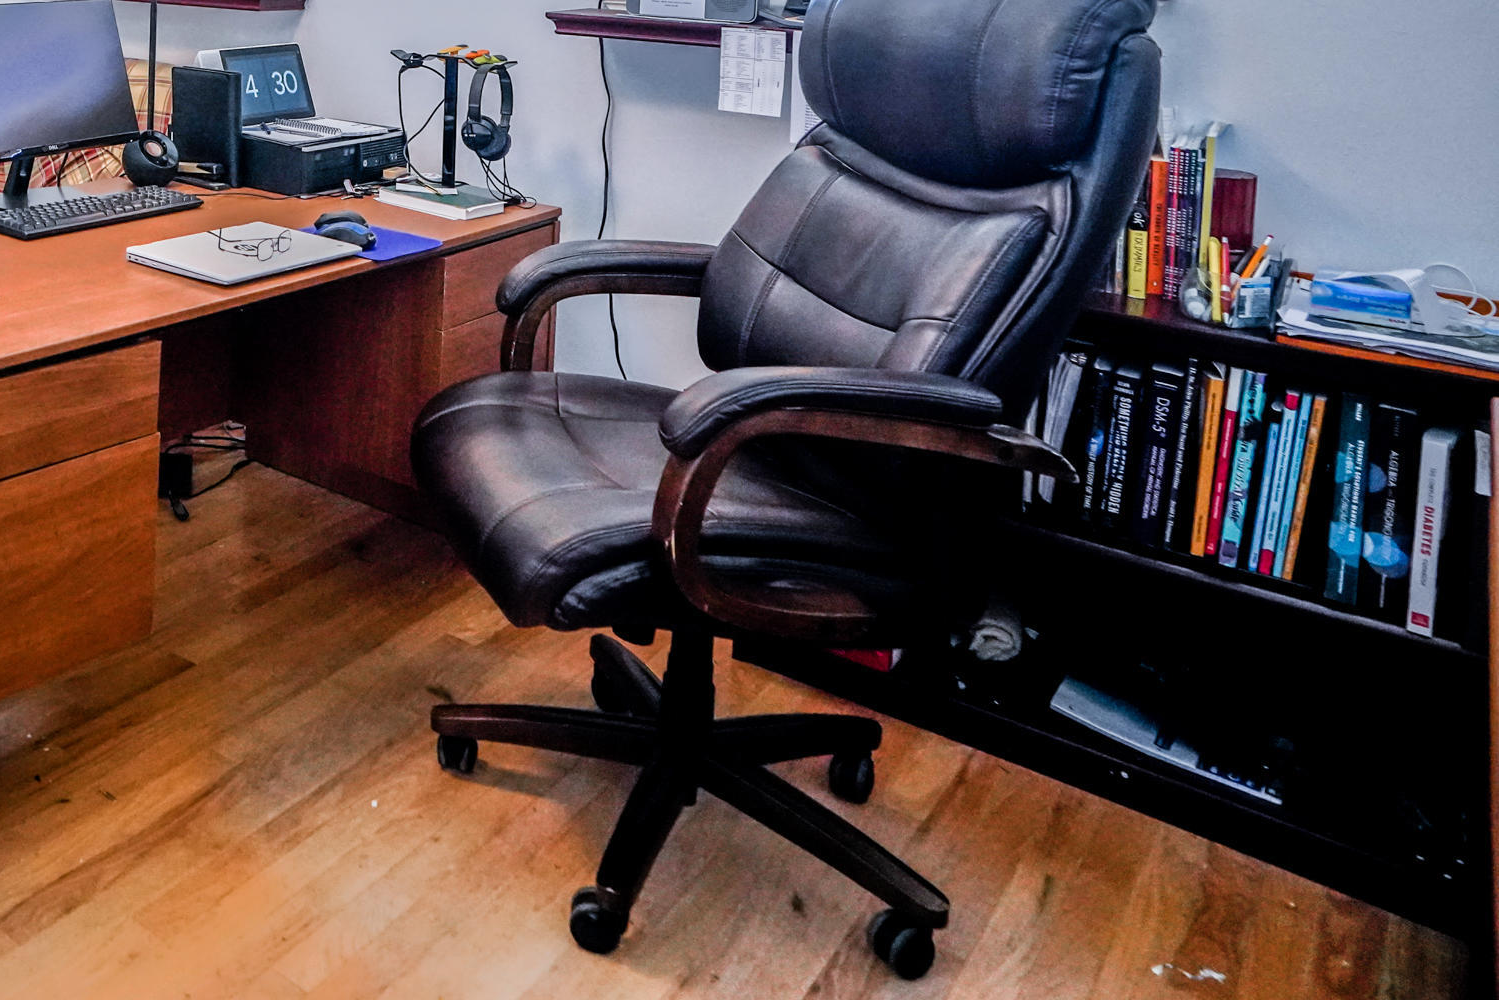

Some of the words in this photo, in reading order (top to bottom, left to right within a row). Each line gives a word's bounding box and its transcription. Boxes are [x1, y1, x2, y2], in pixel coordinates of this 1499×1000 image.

[245, 74, 259, 98] 4
[271, 70, 298, 95] 30
[1154, 213, 1162, 234] FABRIC
[1115, 396, 1133, 447] SOMETHING
[1354, 402, 1364, 422] MILLER
[1149, 446, 1158, 467] MANUAL
[1156, 447, 1167, 477] DIAGNOSTIC
[1176, 450, 1185, 462] and
[1345, 442, 1355, 476] ALGEBRA
[1353, 439, 1366, 471] STUDENT'S
[1085, 461, 1096, 486] HISTORY
[1148, 467, 1157, 475] OF
[1172, 462, 1183, 490] Palestine
[1234, 456, 1251, 497] Survival
[1387, 450, 1400, 488] ALGEBRA
[1085, 486, 1094, 495] OF
[1155, 478, 1163, 490] AND
[1350, 471, 1362, 504] SOLUTIONS
[1083, 494, 1092, 509] TIME
[1107, 482, 1125, 515] HIDDEN
[1150, 489, 1162, 516] STATISTICAL
[1230, 497, 1246, 524] Guide
[1348, 504, 1359, 530] MANUAL
[1420, 505, 1436, 556] DIABETES
[1347, 530, 1356, 543] FOR
